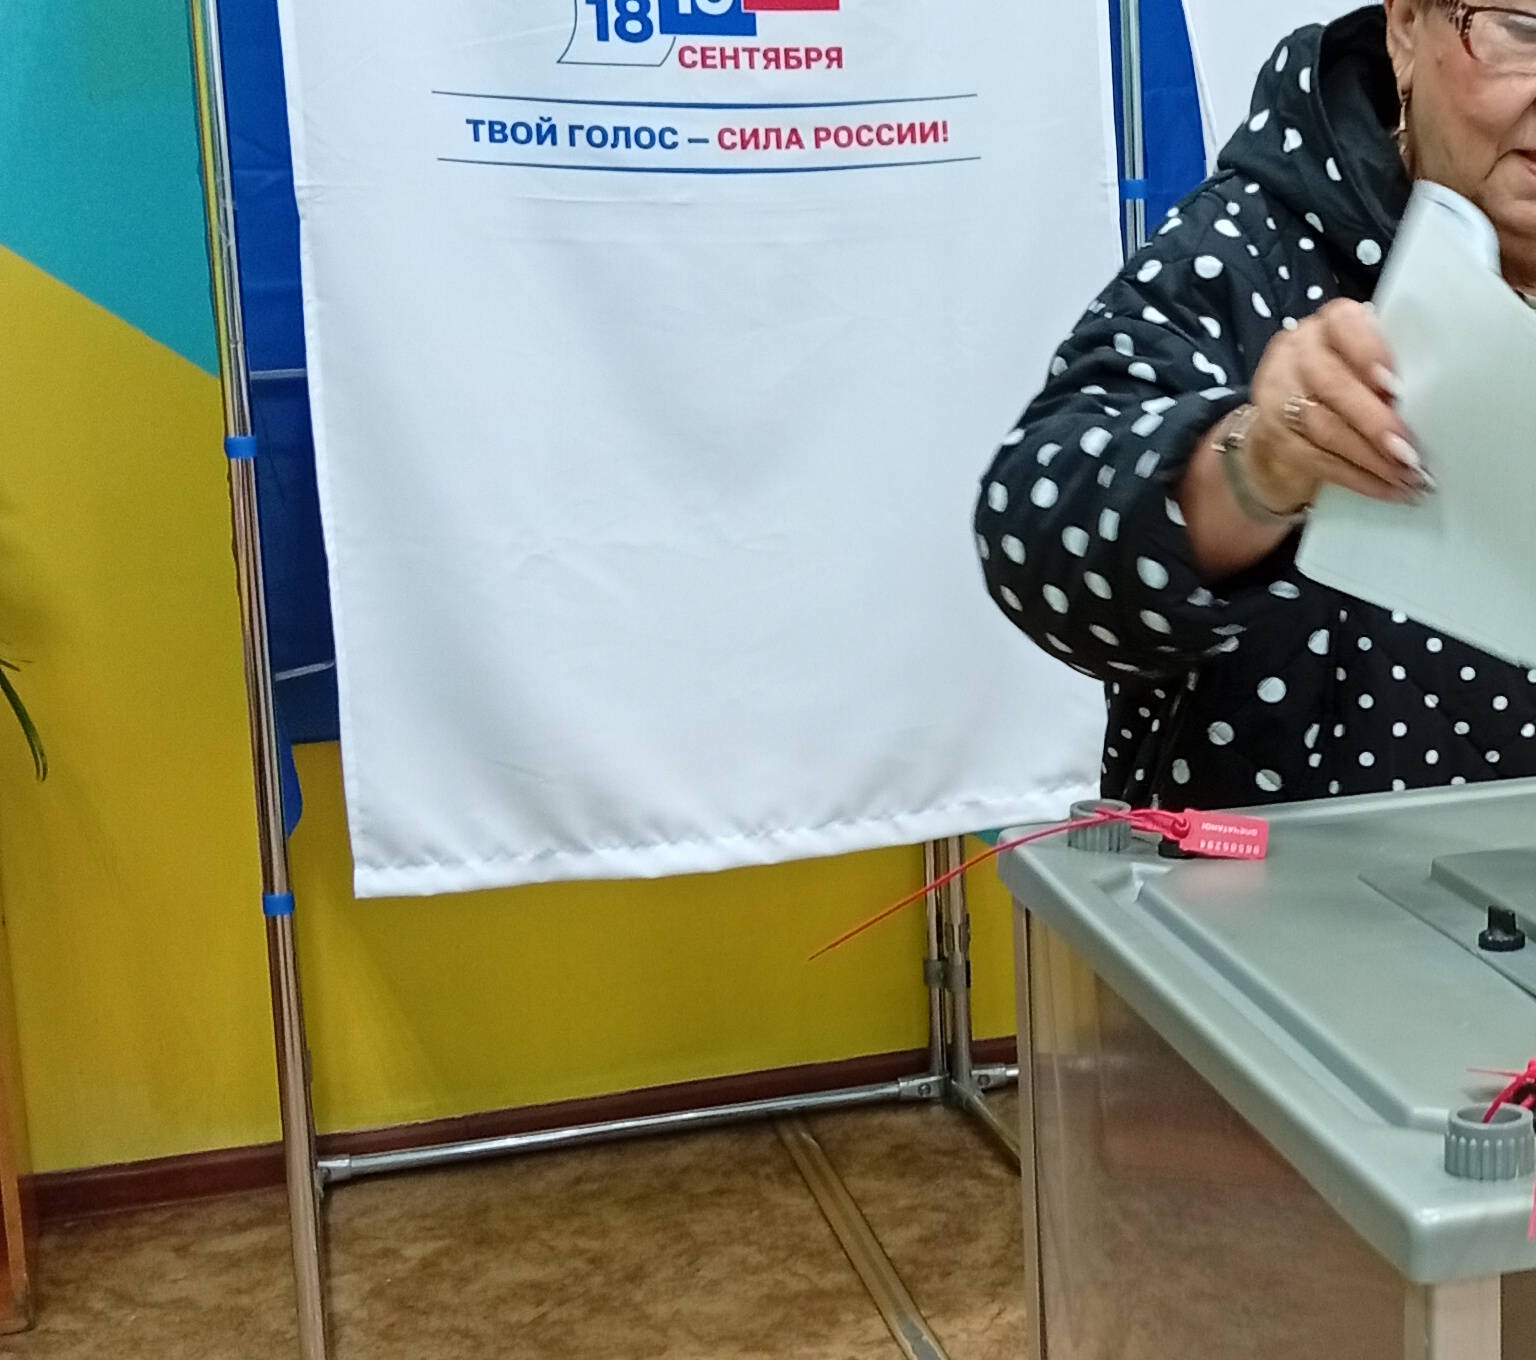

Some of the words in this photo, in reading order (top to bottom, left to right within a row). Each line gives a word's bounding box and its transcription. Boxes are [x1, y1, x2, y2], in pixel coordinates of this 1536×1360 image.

[677, 45, 844, 70] СЕНТЯБРЯ
[465, 116, 558, 148] ТВОЙ
[568, 124, 679, 151] ГОЛОС
[717, 126, 805, 151] СИЛА
[813, 120, 950, 150] РОССИИ!
